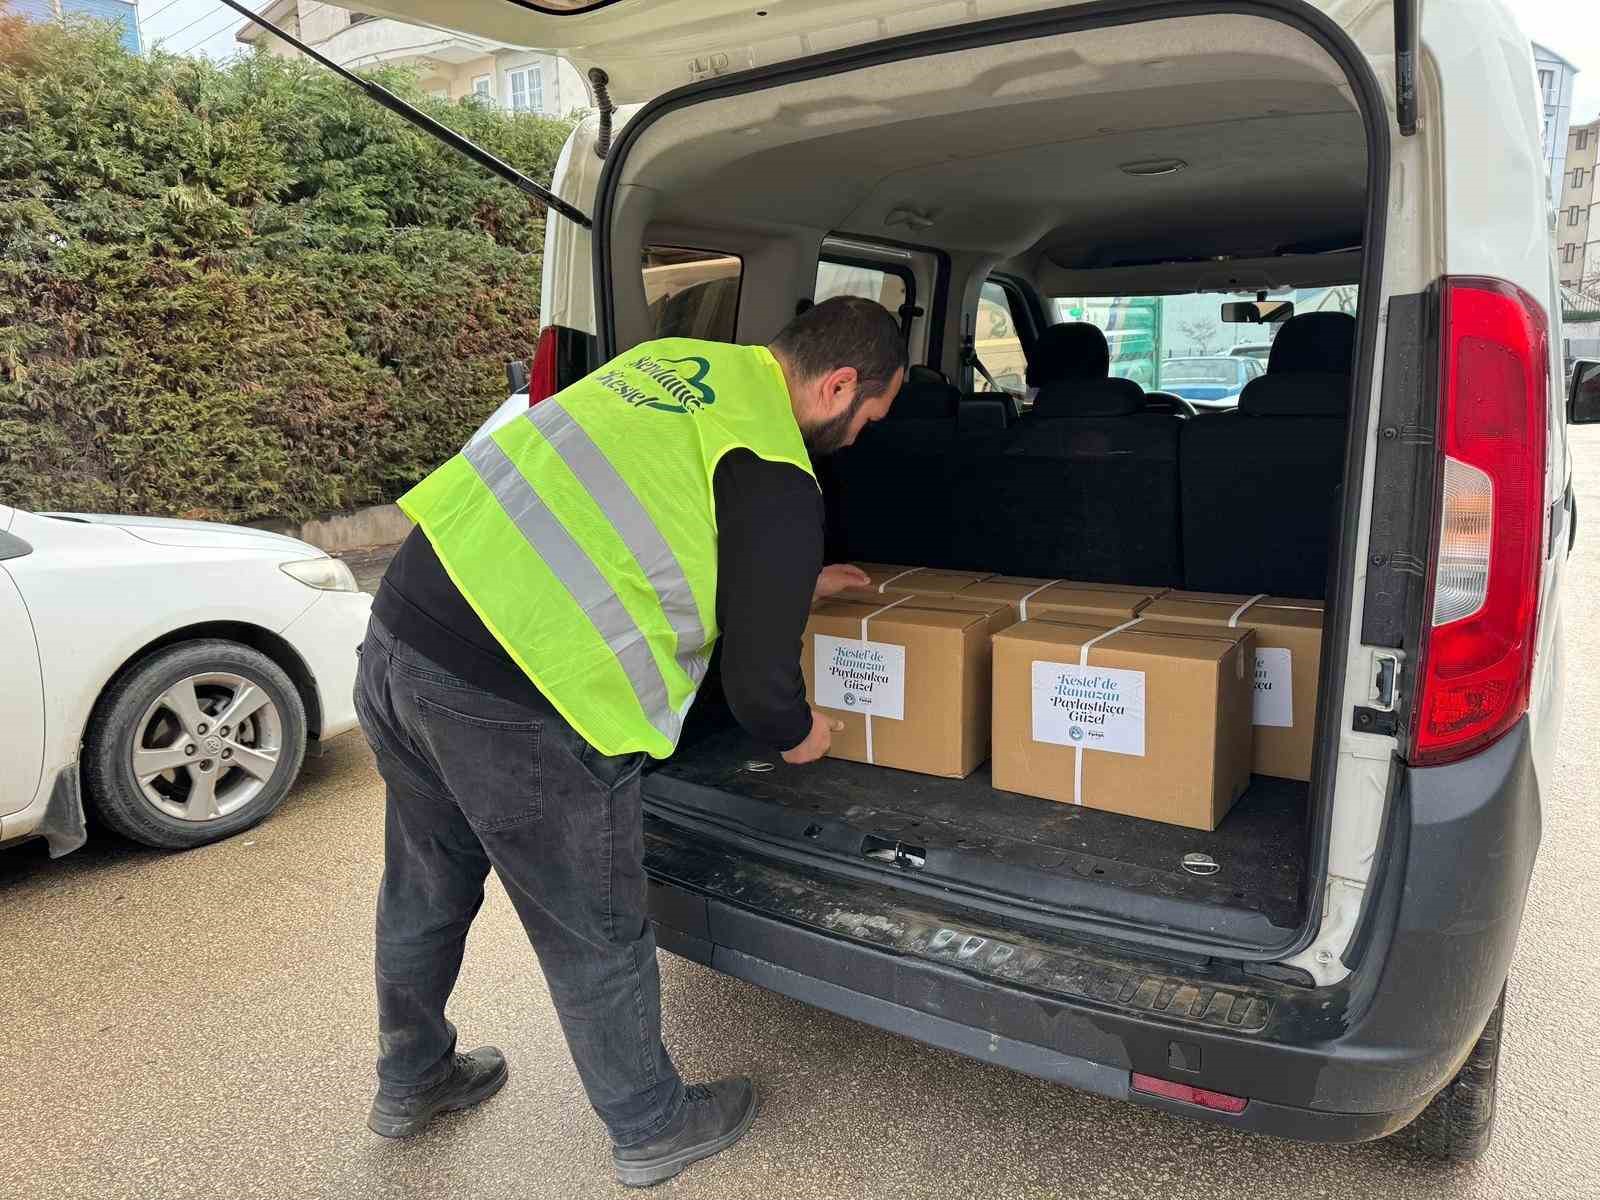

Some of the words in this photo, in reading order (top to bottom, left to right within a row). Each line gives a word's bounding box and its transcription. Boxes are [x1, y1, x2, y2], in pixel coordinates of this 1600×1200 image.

[833, 656, 885, 672] Ramazan
[844, 679, 873, 692] Güzel
[1055, 684, 1121, 702] Ramazan
[1068, 710, 1105, 725] Güzel
